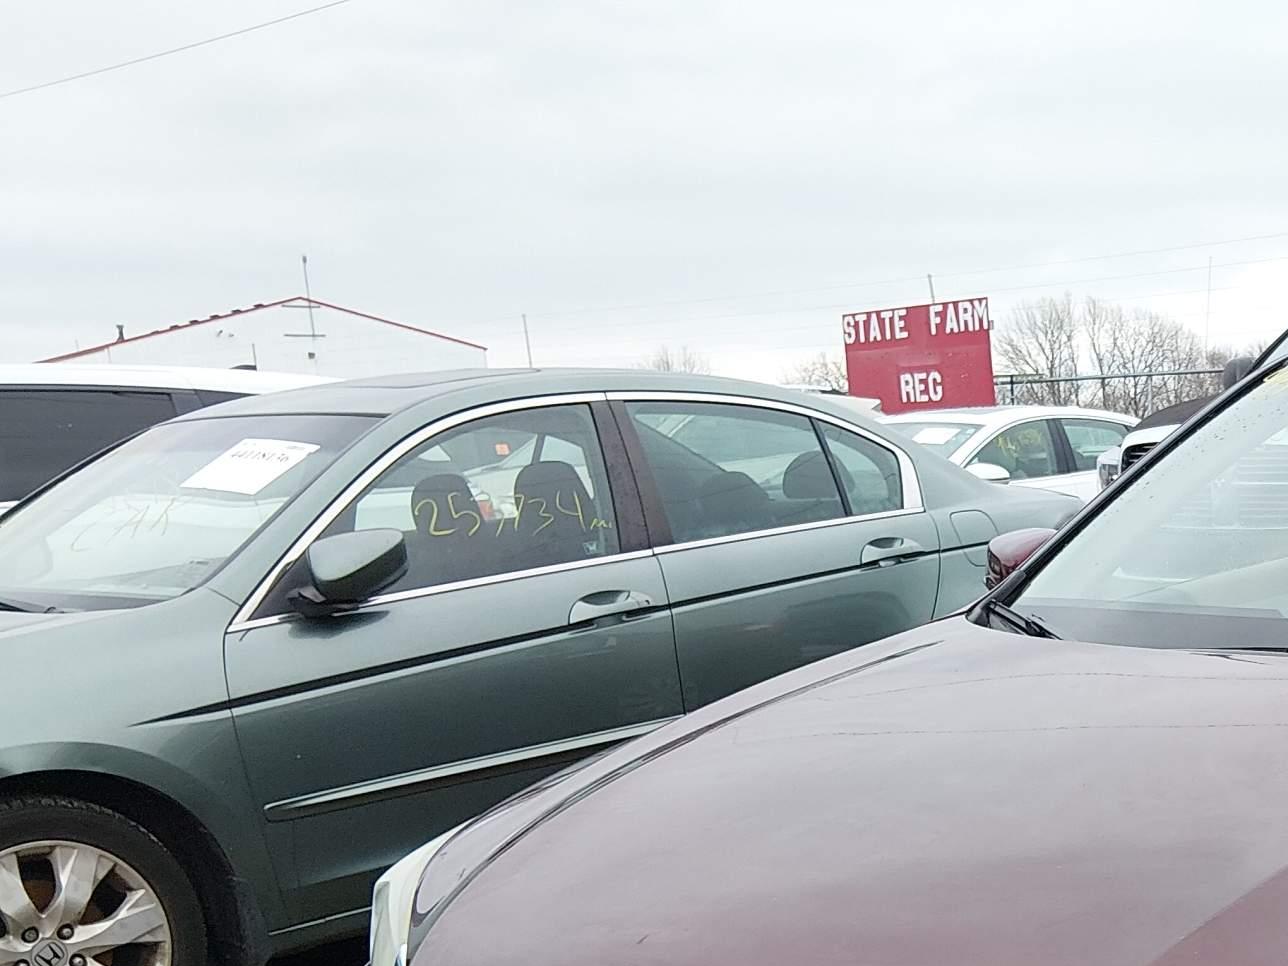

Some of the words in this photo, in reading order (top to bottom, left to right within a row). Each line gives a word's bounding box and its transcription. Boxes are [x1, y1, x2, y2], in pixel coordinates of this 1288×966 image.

[843, 308, 909, 345] STATE
[928, 299, 989, 336] FARM
[899, 370, 944, 404] REG
